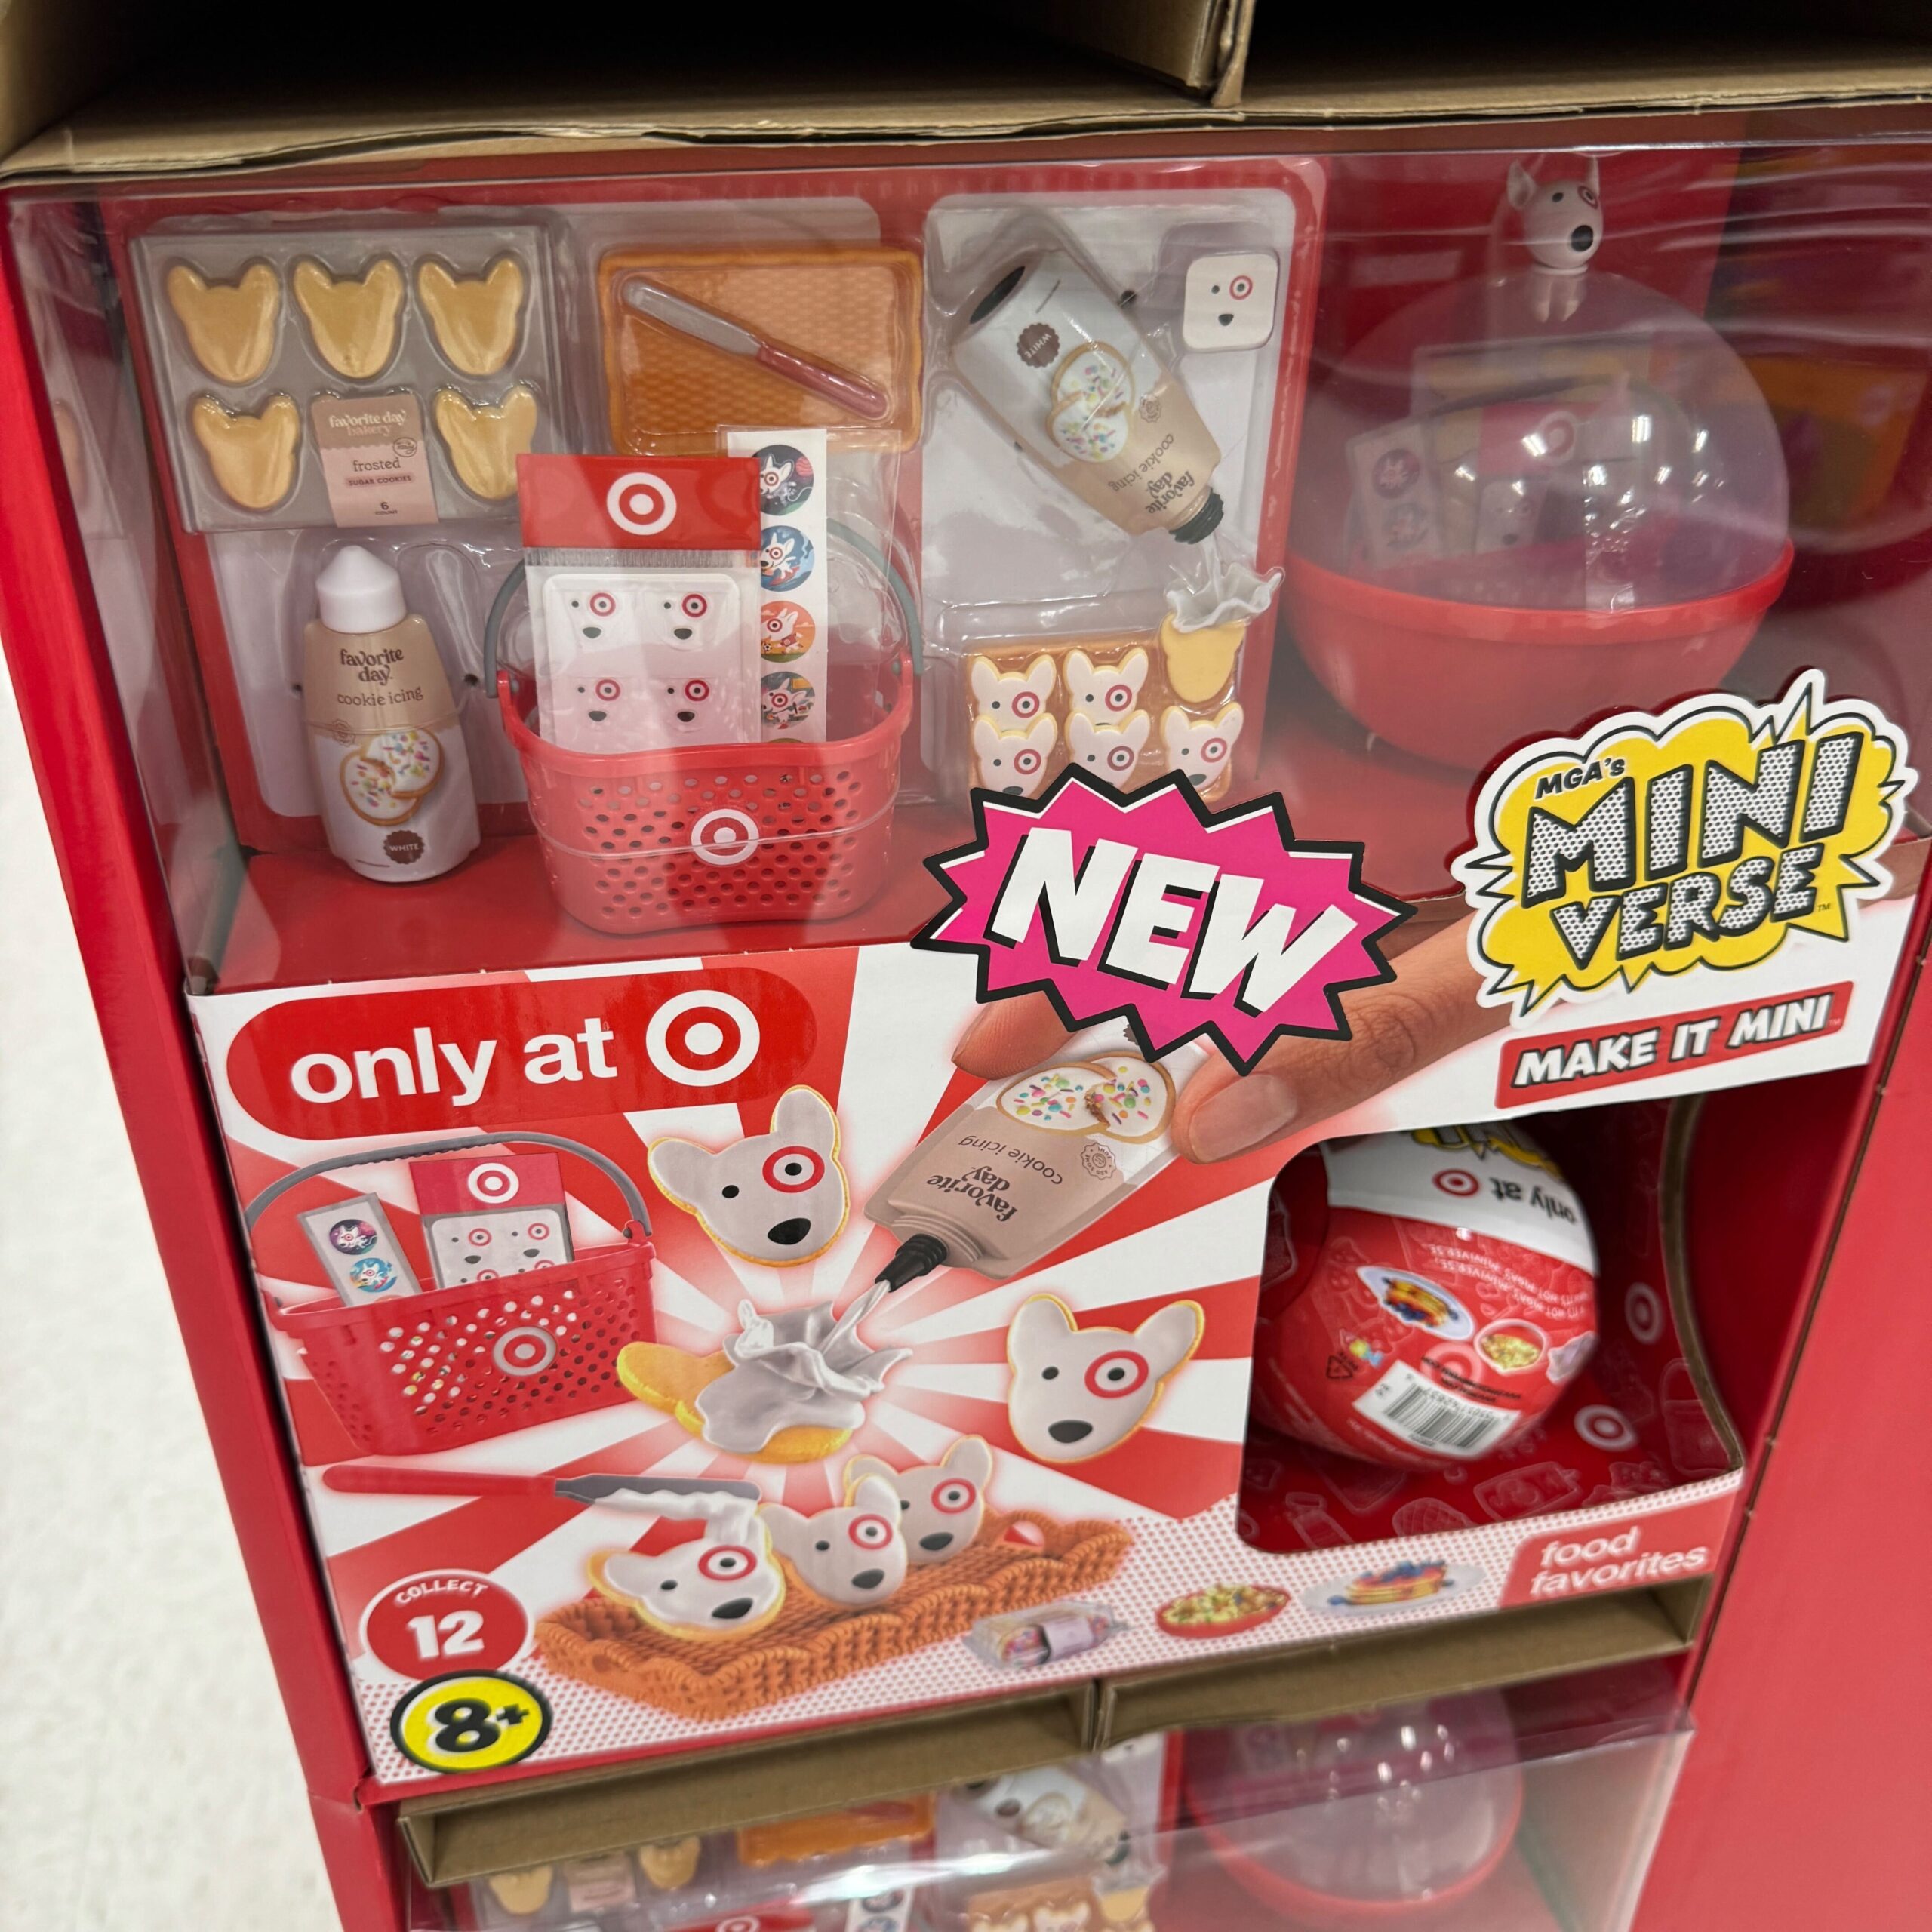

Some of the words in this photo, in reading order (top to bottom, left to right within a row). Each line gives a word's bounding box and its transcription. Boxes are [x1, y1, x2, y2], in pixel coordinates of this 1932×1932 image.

[1024, 333, 1052, 359] WHITE
[328, 411, 381, 428] favorite
[382, 410, 407, 426] day
[346, 424, 391, 437] bakery
[352, 457, 401, 472] frosted
[1138, 433, 1174, 472] cookie
[348, 478, 375, 487] SUGAR
[377, 475, 412, 485] COOKIES
[1107, 469, 1143, 492] icing
[1145, 470, 1195, 514] favorite
[1146, 472, 1173, 499] day
[380, 501, 389, 510] 6
[340, 648, 405, 666] favorite
[358, 666, 392, 686] day
[337, 691, 385, 707] cookie
[387, 685, 424, 704] icing
[1522, 731, 1865, 909] MINI
[389, 842, 420, 852] WHITE
[1549, 842, 1825, 970] VERSE
[984, 826, 1358, 1016] NEW
[1510, 1026, 1660, 1090] MAKE
[1669, 1015, 1722, 1063] IT
[1726, 990, 1835, 1050] MINI
[289, 1026, 497, 1106] only
[523, 1016, 619, 1085] at
[958, 1135, 1007, 1156] icing
[961, 1165, 1011, 1192] day
[1008, 1148, 1063, 1186] cookie
[926, 1174, 1018, 1223] favorite
[1489, 1176, 1523, 1201] at
[1529, 1185, 1577, 1224] only
[1540, 1525, 1641, 1567] food
[1530, 1546, 1709, 1596] favorites
[395, 1578, 488, 1604] COLLECT
[407, 1609, 485, 1660] 12
[429, 1697, 530, 1753] 8+
